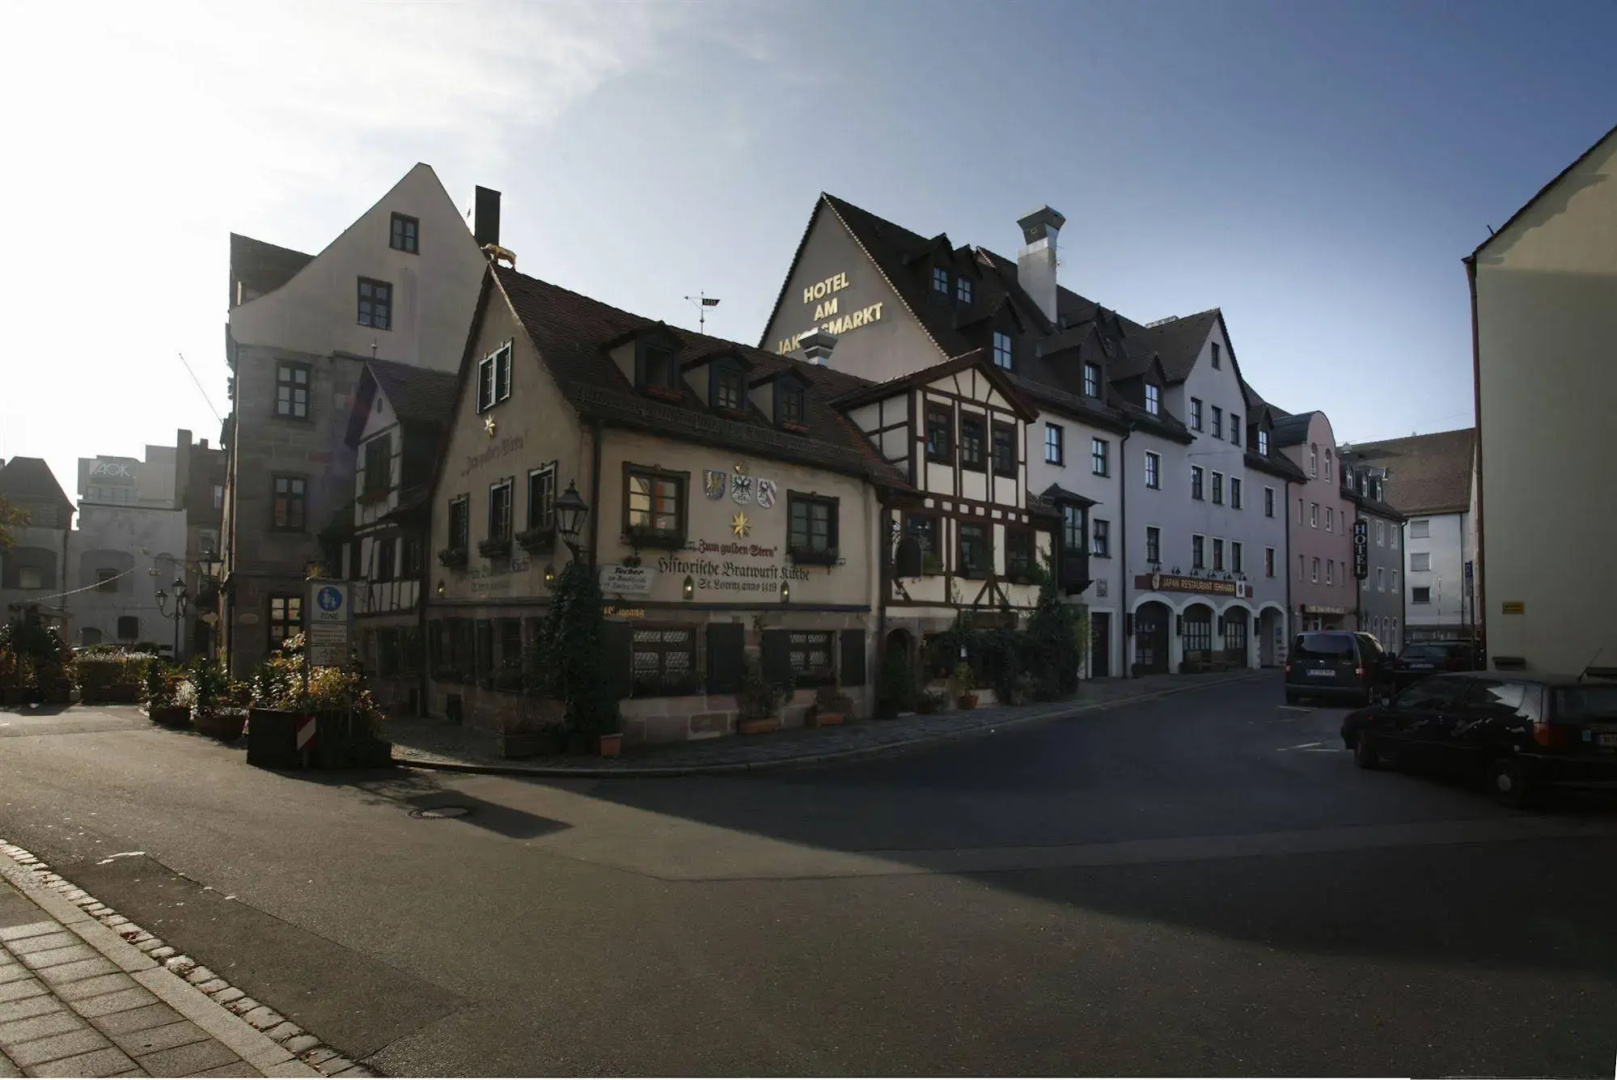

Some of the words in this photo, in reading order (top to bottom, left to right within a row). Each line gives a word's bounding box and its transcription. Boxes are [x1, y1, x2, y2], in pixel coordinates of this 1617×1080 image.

[803, 272, 850, 304] HOTEL
[813, 298, 838, 322] AM
[776, 302, 883, 355] JAKSMARKT
[95, 463, 131, 478] AOK
[1354, 524, 1366, 576] HOTEL
[722, 561, 779, 580] Bratwurst
[1163, 577, 1180, 588] JAPAN
[1180, 579, 1213, 591] RESTAURANT
[320, 612, 339, 620] ZONE
